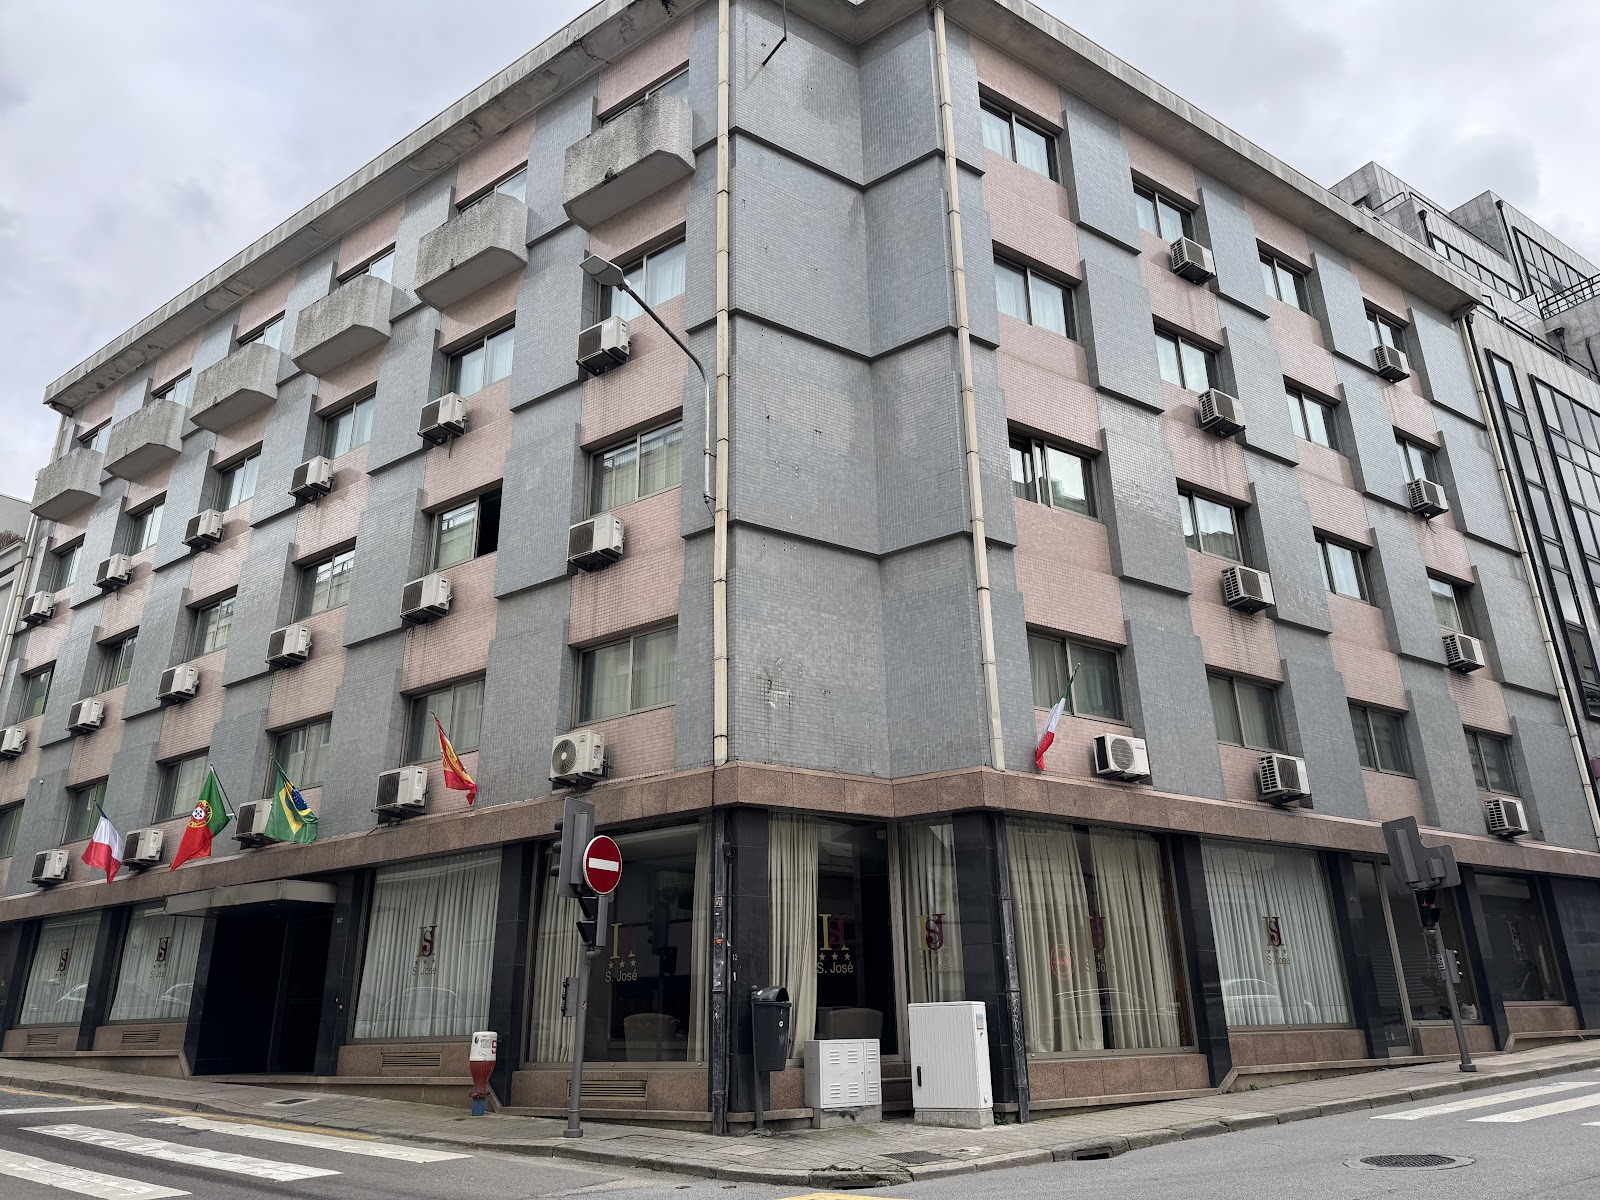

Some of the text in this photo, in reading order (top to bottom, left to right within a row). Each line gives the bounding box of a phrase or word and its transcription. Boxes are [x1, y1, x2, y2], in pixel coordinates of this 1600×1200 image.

[816, 961, 854, 974] S. José
[605, 969, 638, 982] S. José
